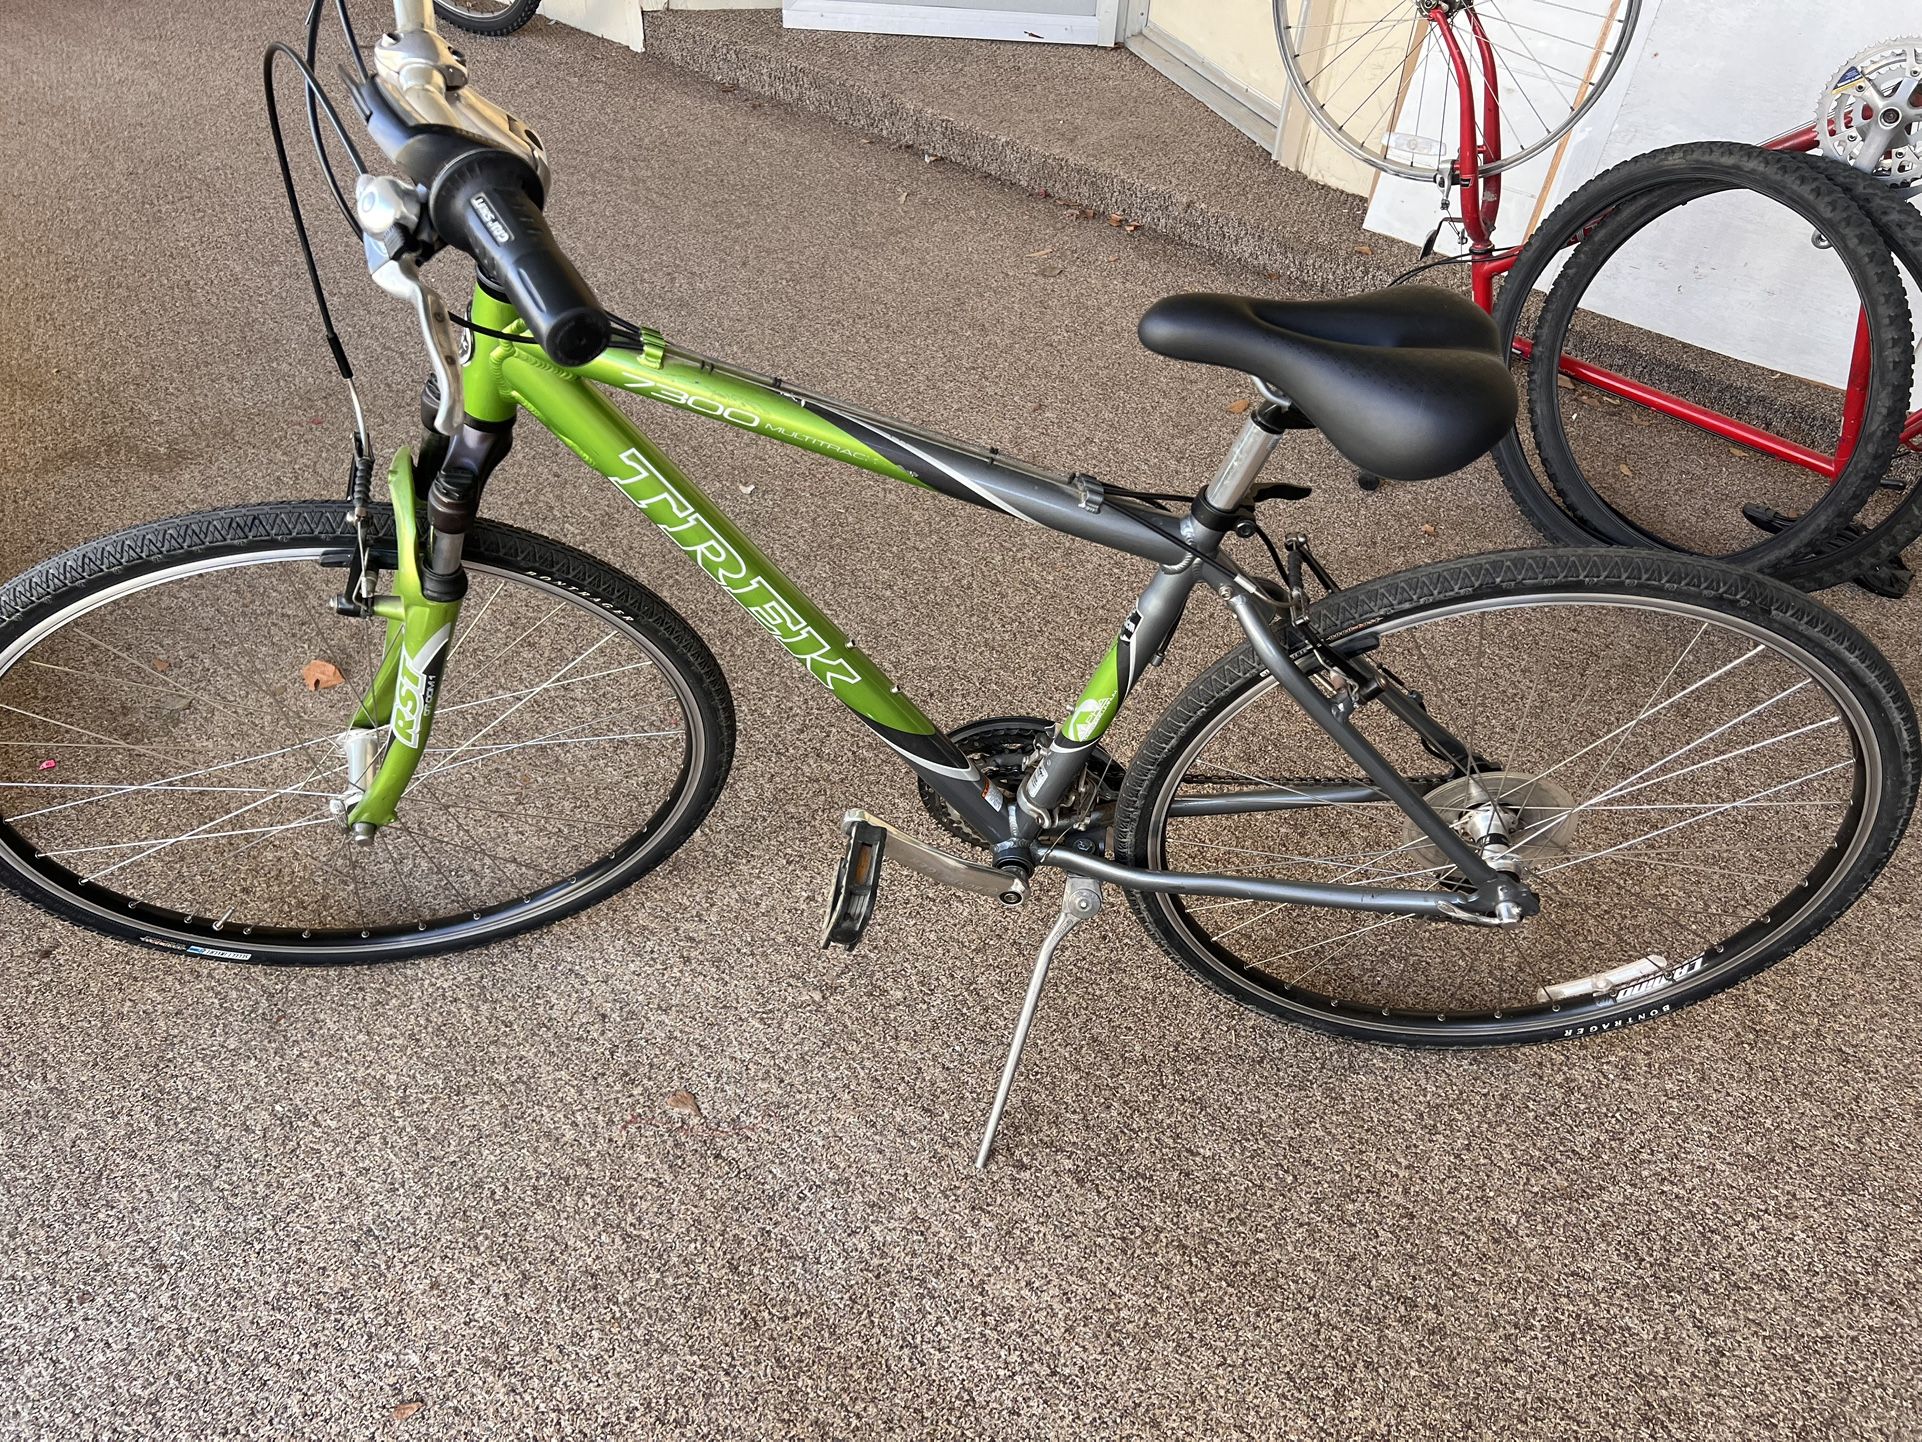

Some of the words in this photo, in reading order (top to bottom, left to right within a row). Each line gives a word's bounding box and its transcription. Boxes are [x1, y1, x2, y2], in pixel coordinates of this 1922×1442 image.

[621, 371, 761, 428] 7300
[525, 571, 635, 621] BONTRAGER
[607, 447, 862, 690] TREK
[391, 643, 427, 749] RST
[1563, 1004, 1670, 1037] BONTRAGER
